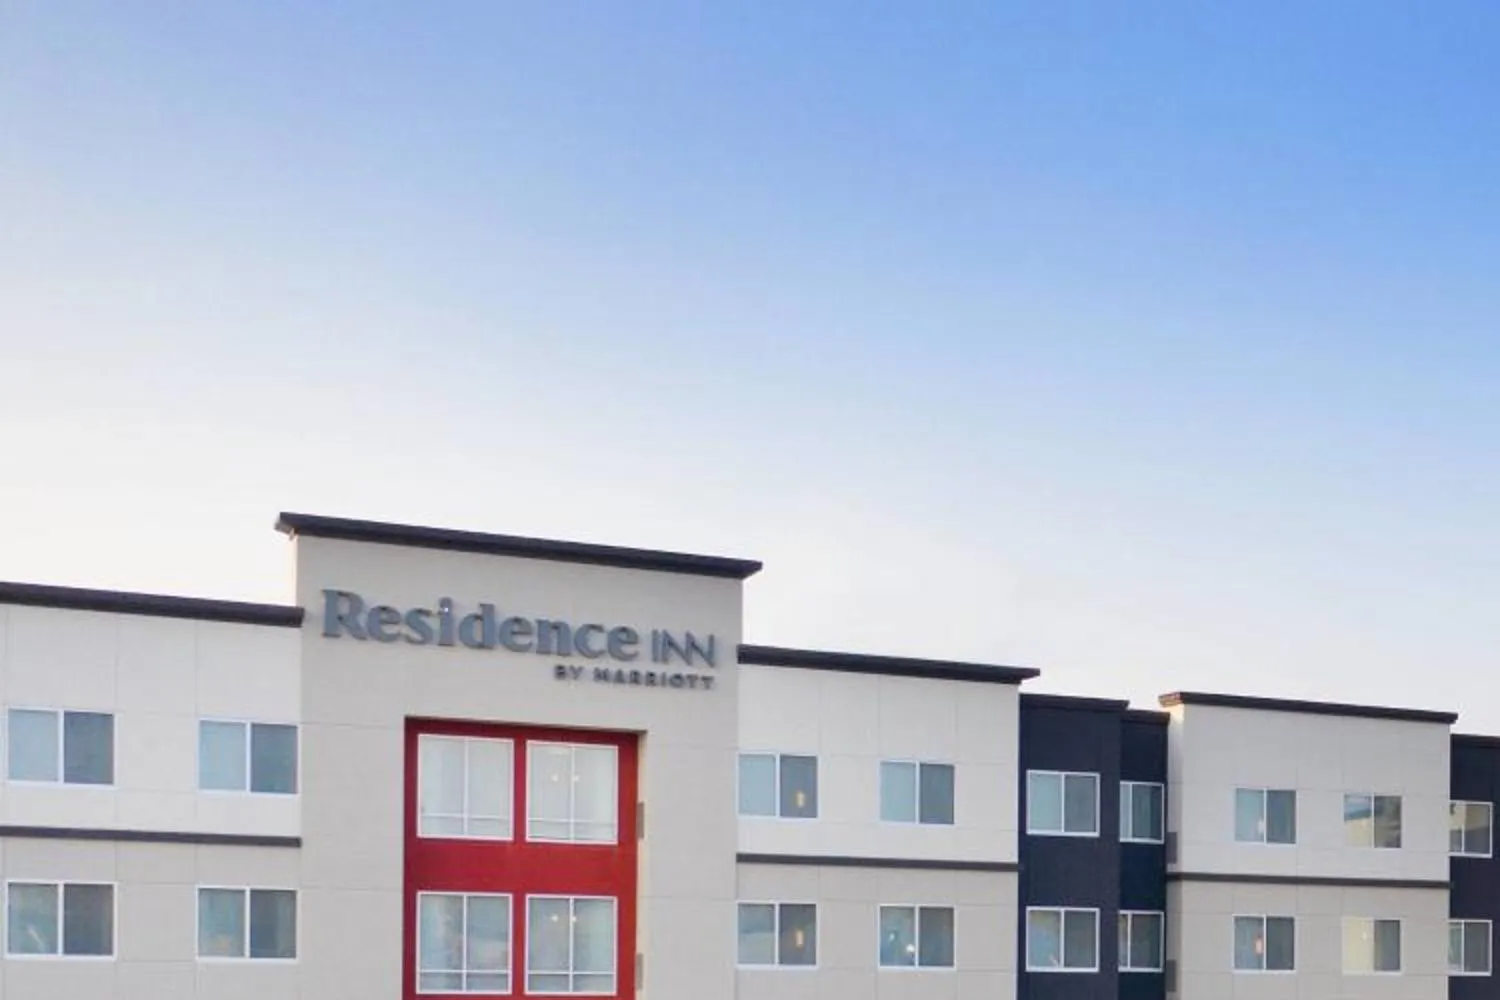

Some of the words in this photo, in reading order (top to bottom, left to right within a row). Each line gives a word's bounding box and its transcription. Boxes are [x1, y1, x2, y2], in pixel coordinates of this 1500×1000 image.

[321, 589, 640, 661] Residence
[651, 629, 717, 668] INN
[554, 665, 583, 680] BY
[593, 667, 715, 690] MARRIOTT
